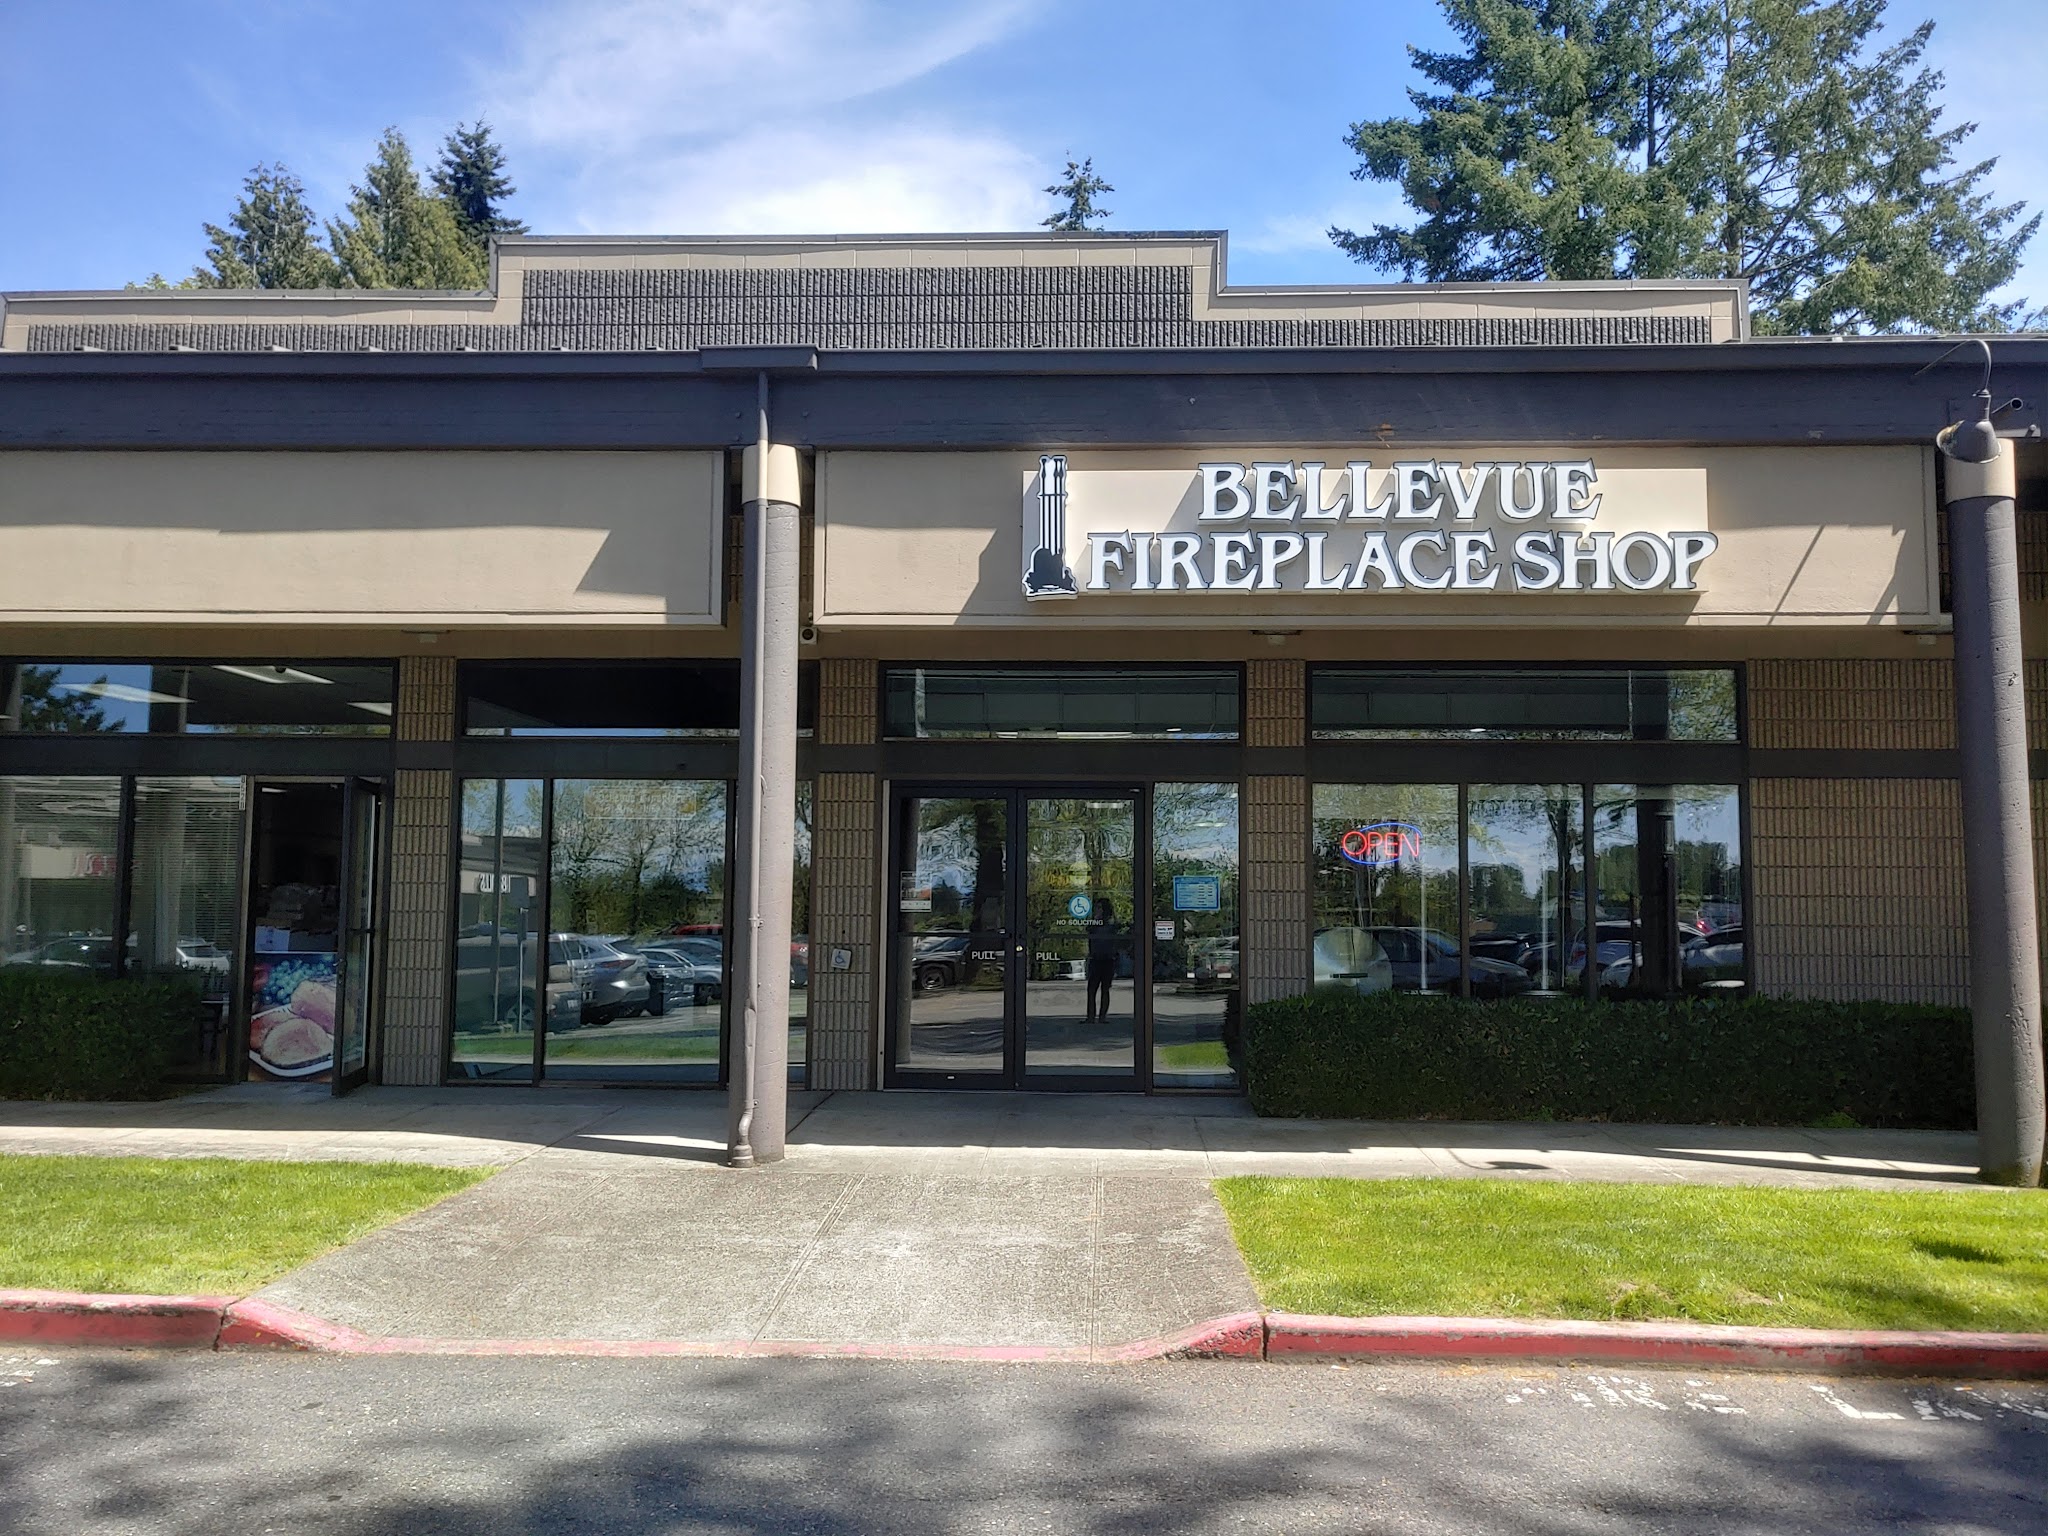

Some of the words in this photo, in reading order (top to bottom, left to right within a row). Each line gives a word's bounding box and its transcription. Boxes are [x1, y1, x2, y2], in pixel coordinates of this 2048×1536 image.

[1197, 457, 1603, 523] BELLEVUE
[1086, 528, 1500, 594] FIREPLACE
[1511, 529, 1719, 593] SHOP
[1341, 831, 1420, 857] OPEN
[971, 951, 996, 960] PULL
[1036, 952, 1061, 961] PULL
